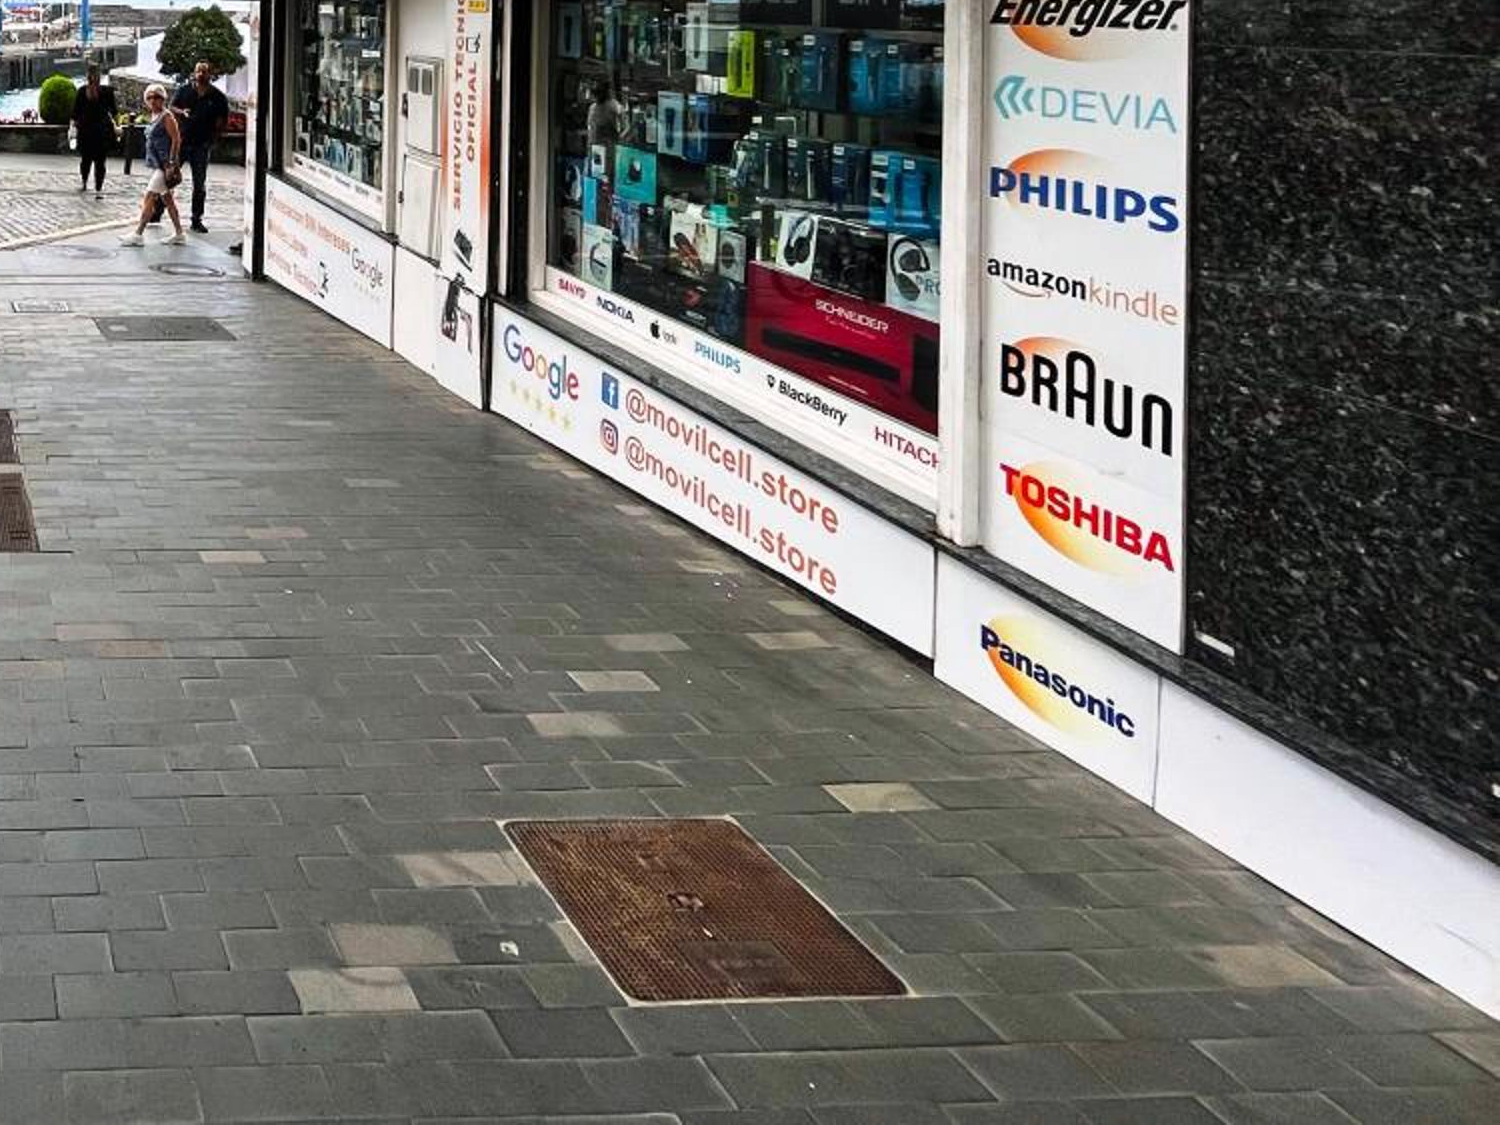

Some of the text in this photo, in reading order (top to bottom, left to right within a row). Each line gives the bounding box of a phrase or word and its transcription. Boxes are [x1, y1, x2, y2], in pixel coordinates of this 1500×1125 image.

[466, 61, 477, 163] OFICIAL
[1039, 86, 1177, 134] DEVIA
[453, 92, 463, 211] SERVICIO
[989, 166, 1180, 233] PHILIPS
[557, 278, 587, 299] SANYO
[595, 295, 635, 324] NOKIA
[815, 298, 889, 334] SCHNEIDER
[503, 324, 580, 401] Google
[694, 340, 741, 374] PHILIPS
[778, 379, 847, 426] BlackBerry
[1000, 343, 1173, 458] BRAUN
[625, 387, 840, 534] @movilcell.store
[625, 435, 838, 596] @movilcell.store
[999, 463, 1175, 573] TOSHIBA
[980, 623, 1135, 739] Panasonic
